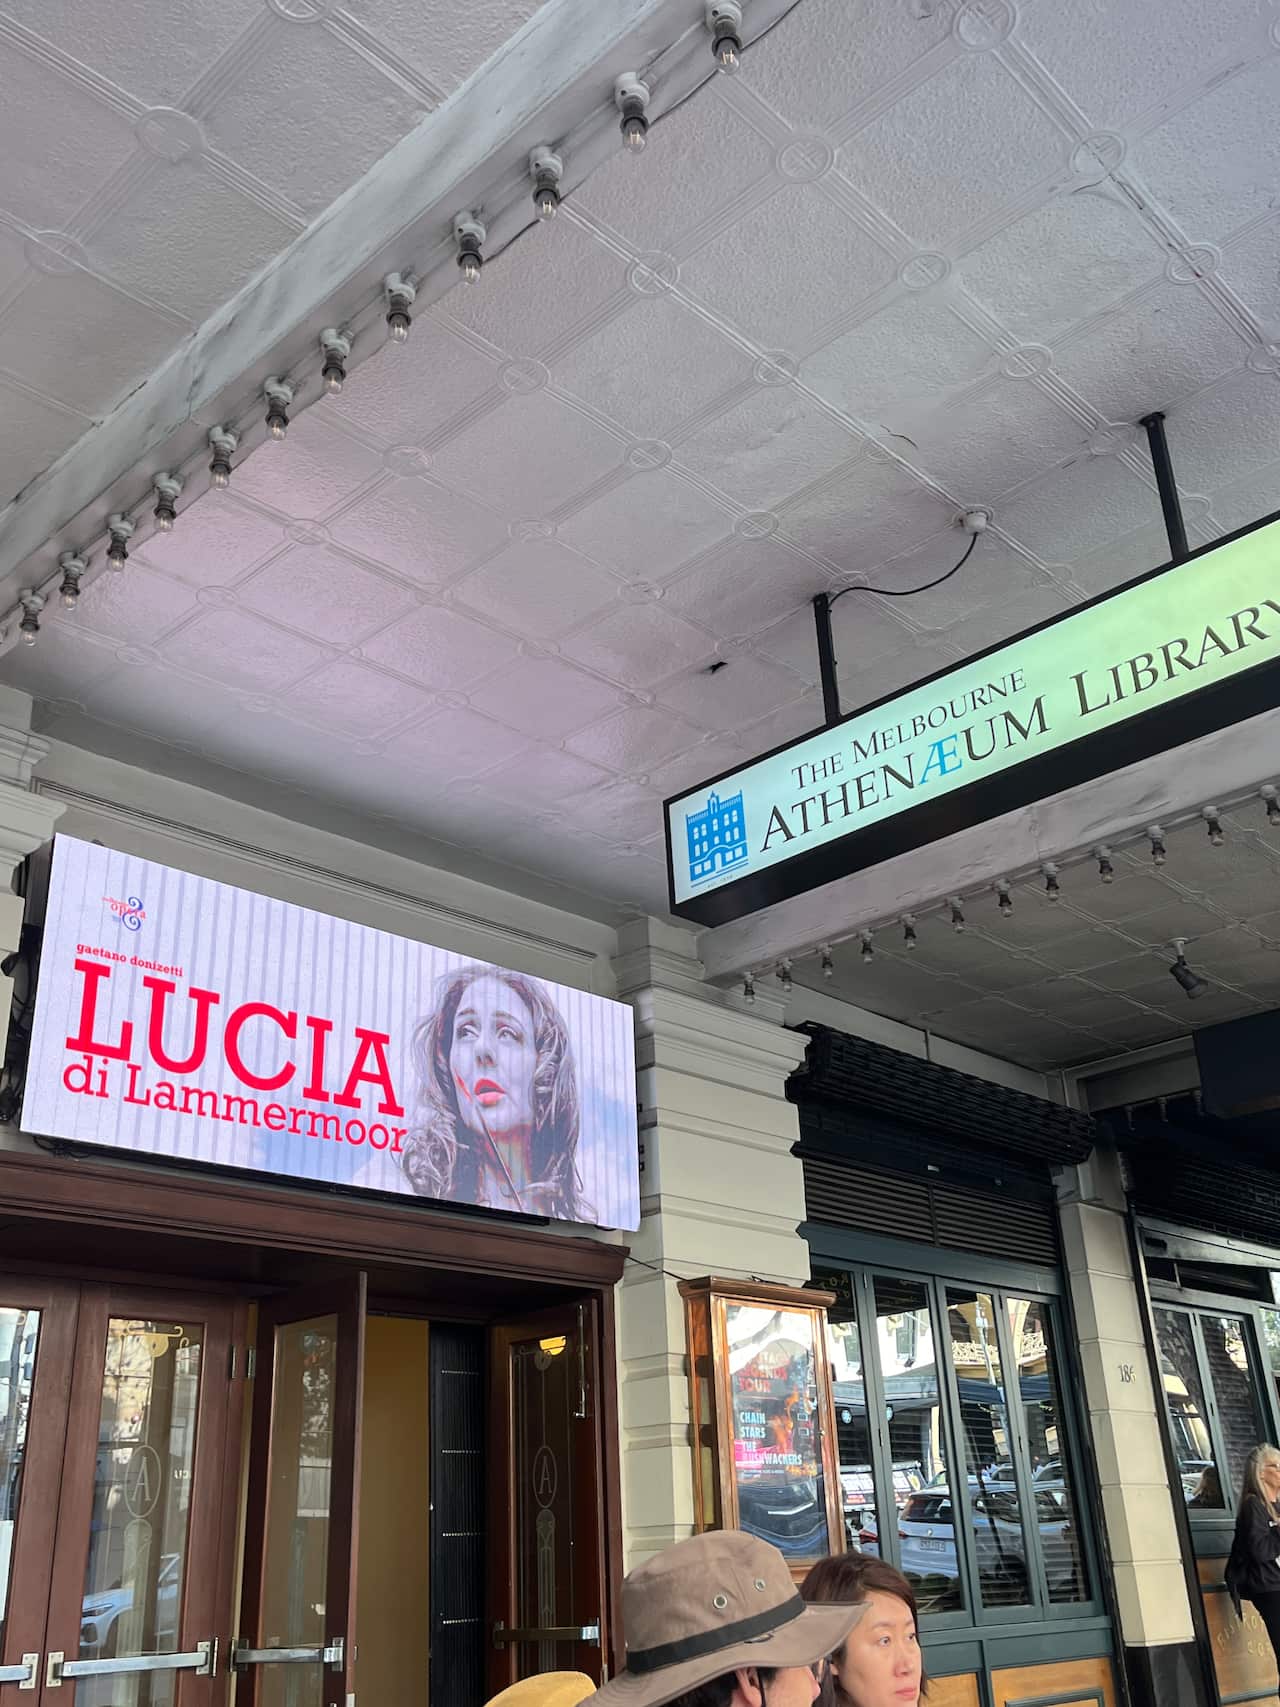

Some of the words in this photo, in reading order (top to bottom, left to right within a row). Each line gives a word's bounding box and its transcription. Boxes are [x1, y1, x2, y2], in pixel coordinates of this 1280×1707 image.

[791, 754, 844, 790] THE
[853, 668, 1027, 765] MELBOURNE
[759, 694, 1053, 852] ATHENÆUM
[76, 943, 127, 962] gaetano
[129, 954, 184, 977] donizetti
[65, 958, 405, 1118] LUCIA
[62, 1055, 109, 1099] di
[124, 1062, 408, 1153] Lammermoor
[740, 1411, 766, 1425] CHAIN
[740, 1426, 766, 1439] STARS
[743, 1441, 757, 1453] THE
